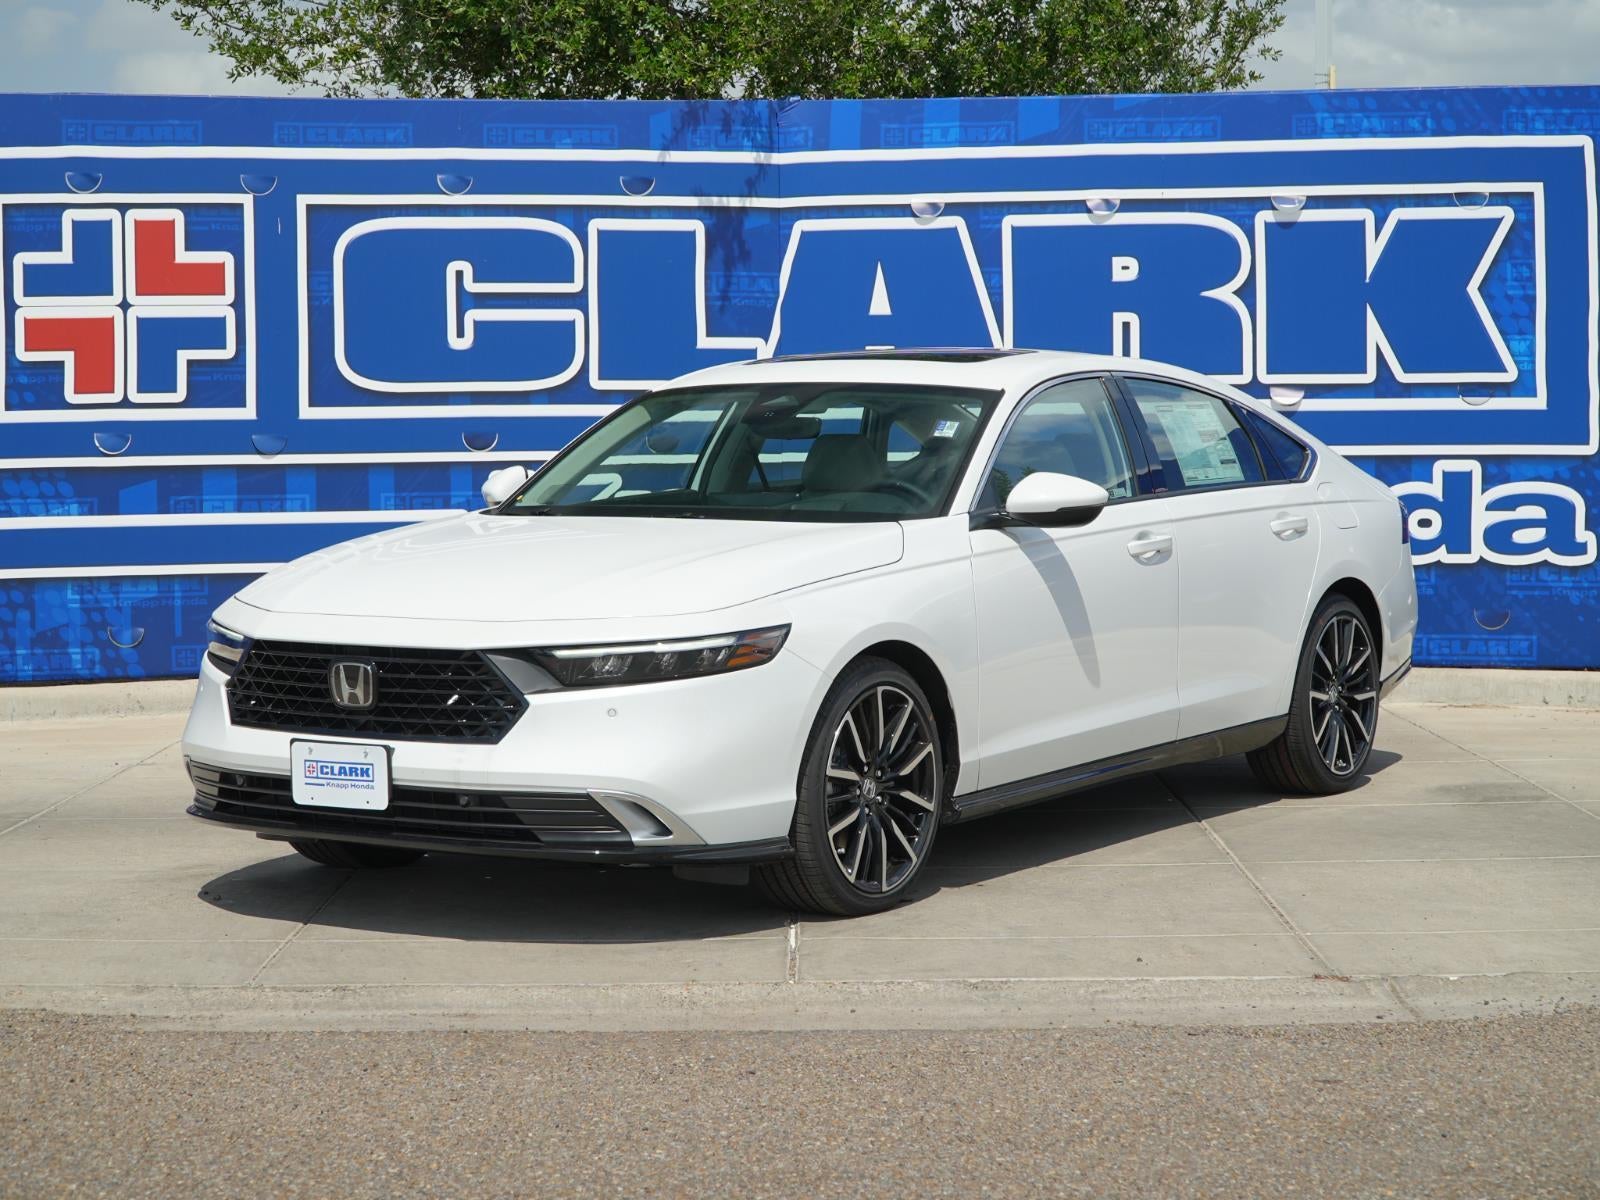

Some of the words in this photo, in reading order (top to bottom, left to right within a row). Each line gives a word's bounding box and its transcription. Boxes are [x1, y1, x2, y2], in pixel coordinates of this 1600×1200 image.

[94, 124, 197, 142] CLARK
[305, 127, 409, 144] CLARK
[514, 128, 614, 144] CLARK
[911, 126, 1011, 143] CLARK
[332, 206, 1518, 393] CLARK
[1390, 459, 1597, 567] da
[1428, 639, 1531, 656] CLARK
[319, 764, 371, 778] CLARK
[326, 781, 349, 790] Knapp
